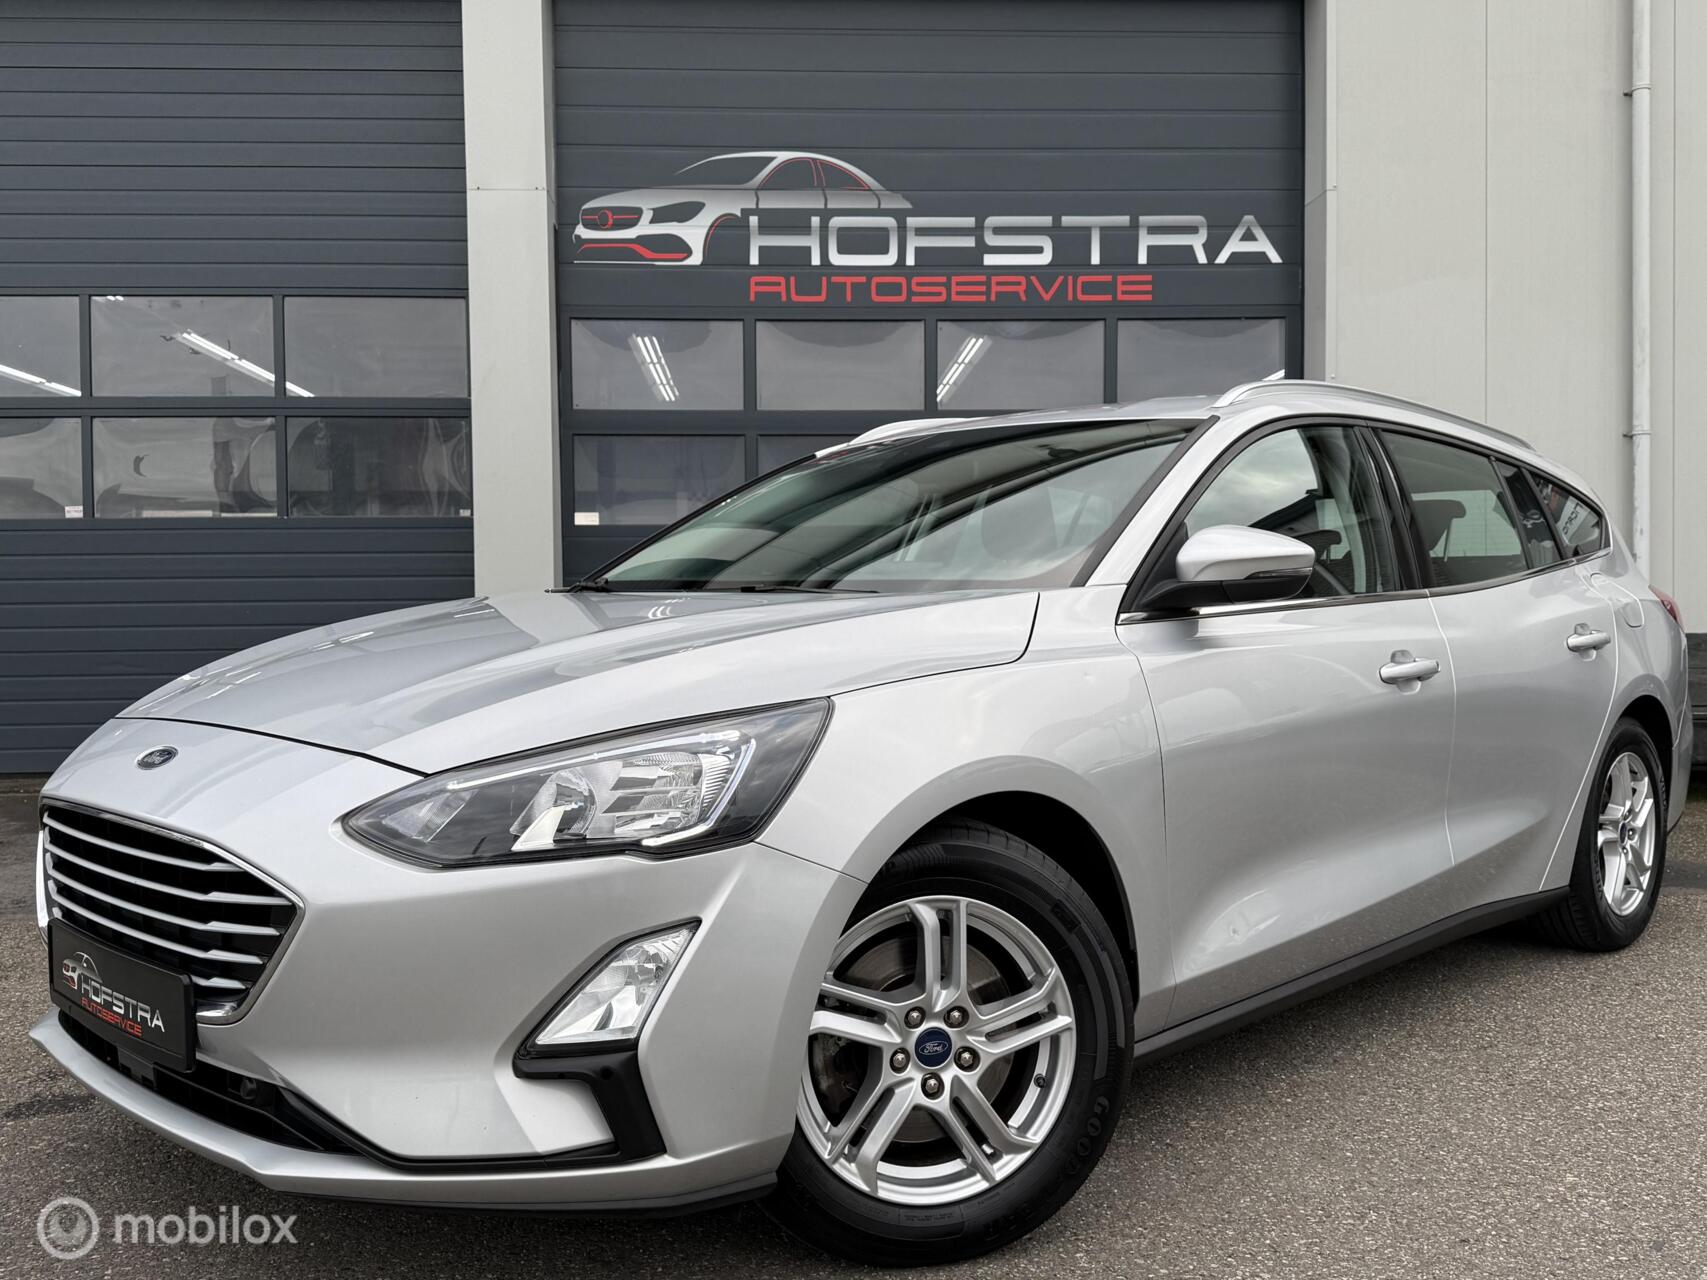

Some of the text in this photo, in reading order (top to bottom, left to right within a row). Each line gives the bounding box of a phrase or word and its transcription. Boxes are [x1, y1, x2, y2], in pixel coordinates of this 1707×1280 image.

[749, 214, 1283, 266] HOFSTRA
[749, 274, 1153, 303] AUTOSERVICE
[81, 974, 165, 1032] HOFSTRA
[923, 1042, 944, 1054] Ford
